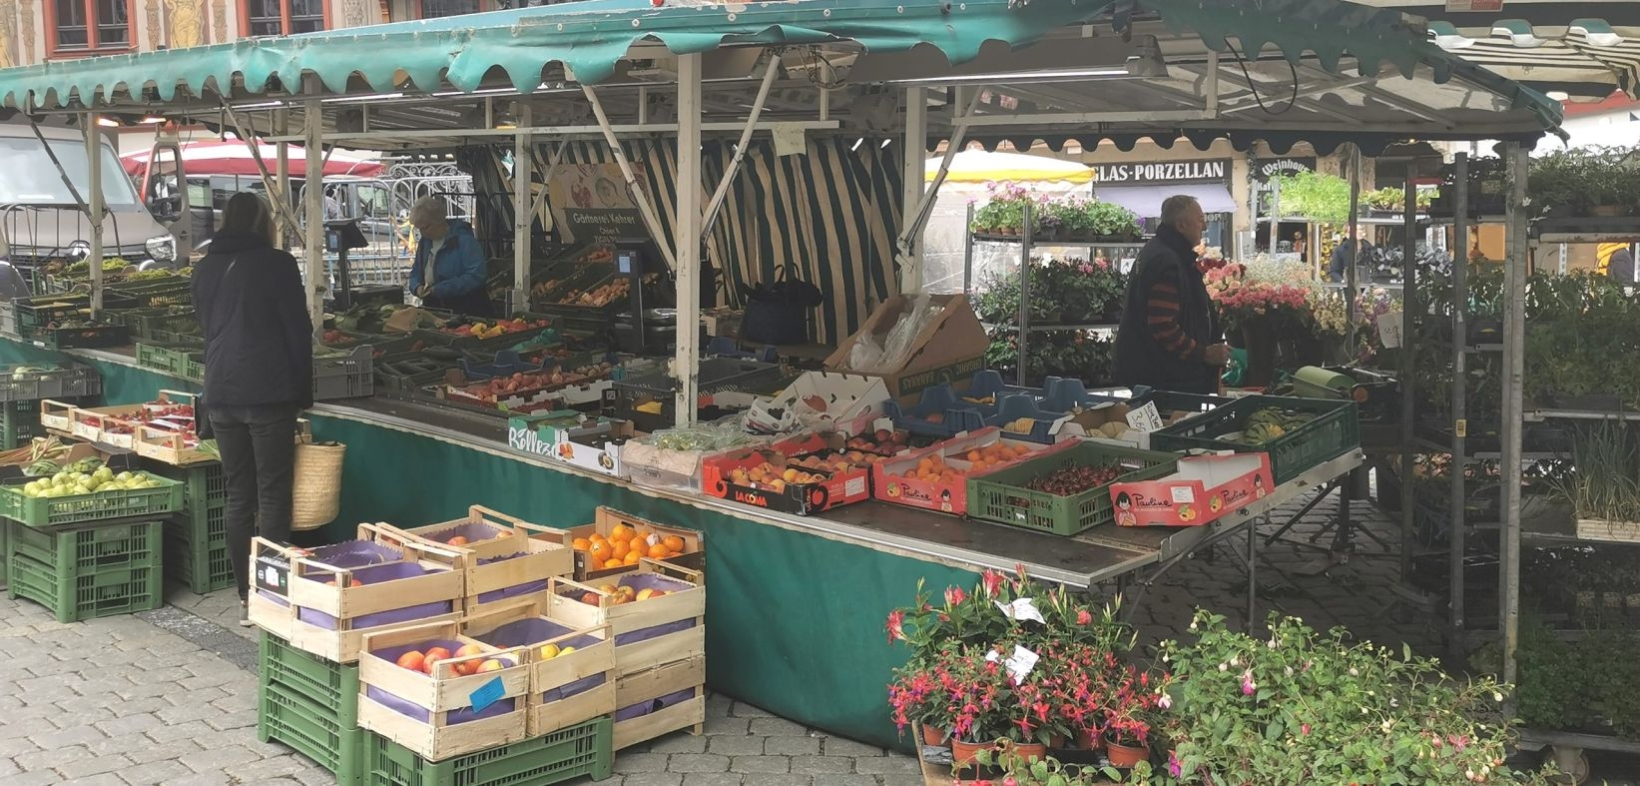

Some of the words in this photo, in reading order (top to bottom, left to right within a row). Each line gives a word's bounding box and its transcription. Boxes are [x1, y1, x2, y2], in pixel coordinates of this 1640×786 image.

[735, 490, 745, 502] LA
[745, 492, 767, 507] COMA
[901, 483, 932, 501] Pauline
[1132, 493, 1172, 508] Pauline
